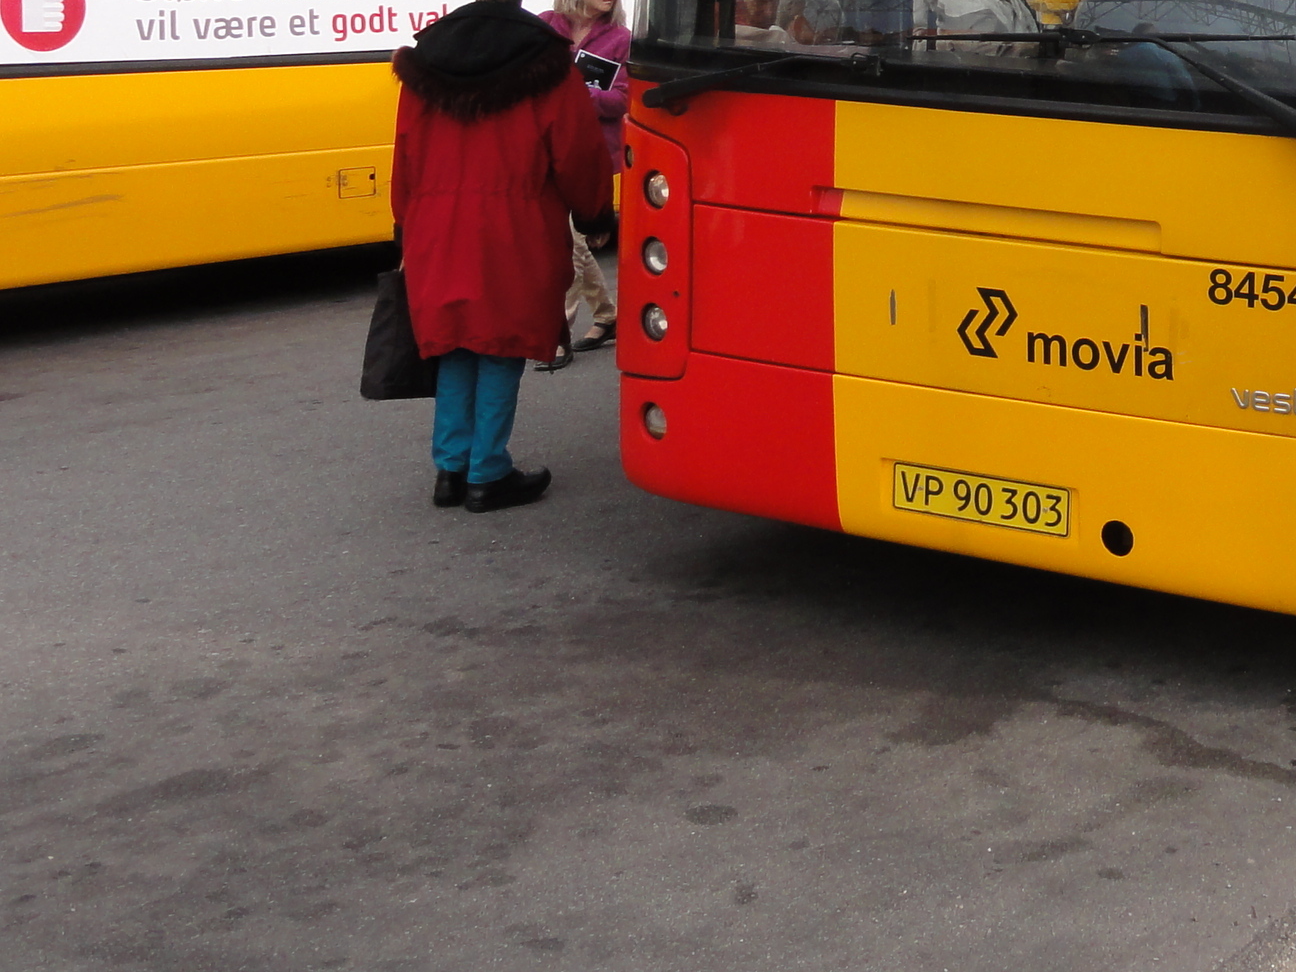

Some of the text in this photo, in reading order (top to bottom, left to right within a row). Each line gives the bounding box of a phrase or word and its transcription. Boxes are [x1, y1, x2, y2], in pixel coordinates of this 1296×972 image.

[136, 9, 180, 41] vil
[193, 14, 276, 40] være
[289, 8, 320, 36] et
[332, 5, 398, 42] godt
[1027, 331, 1174, 381] movia
[901, 471, 1062, 527] VP 90 303
